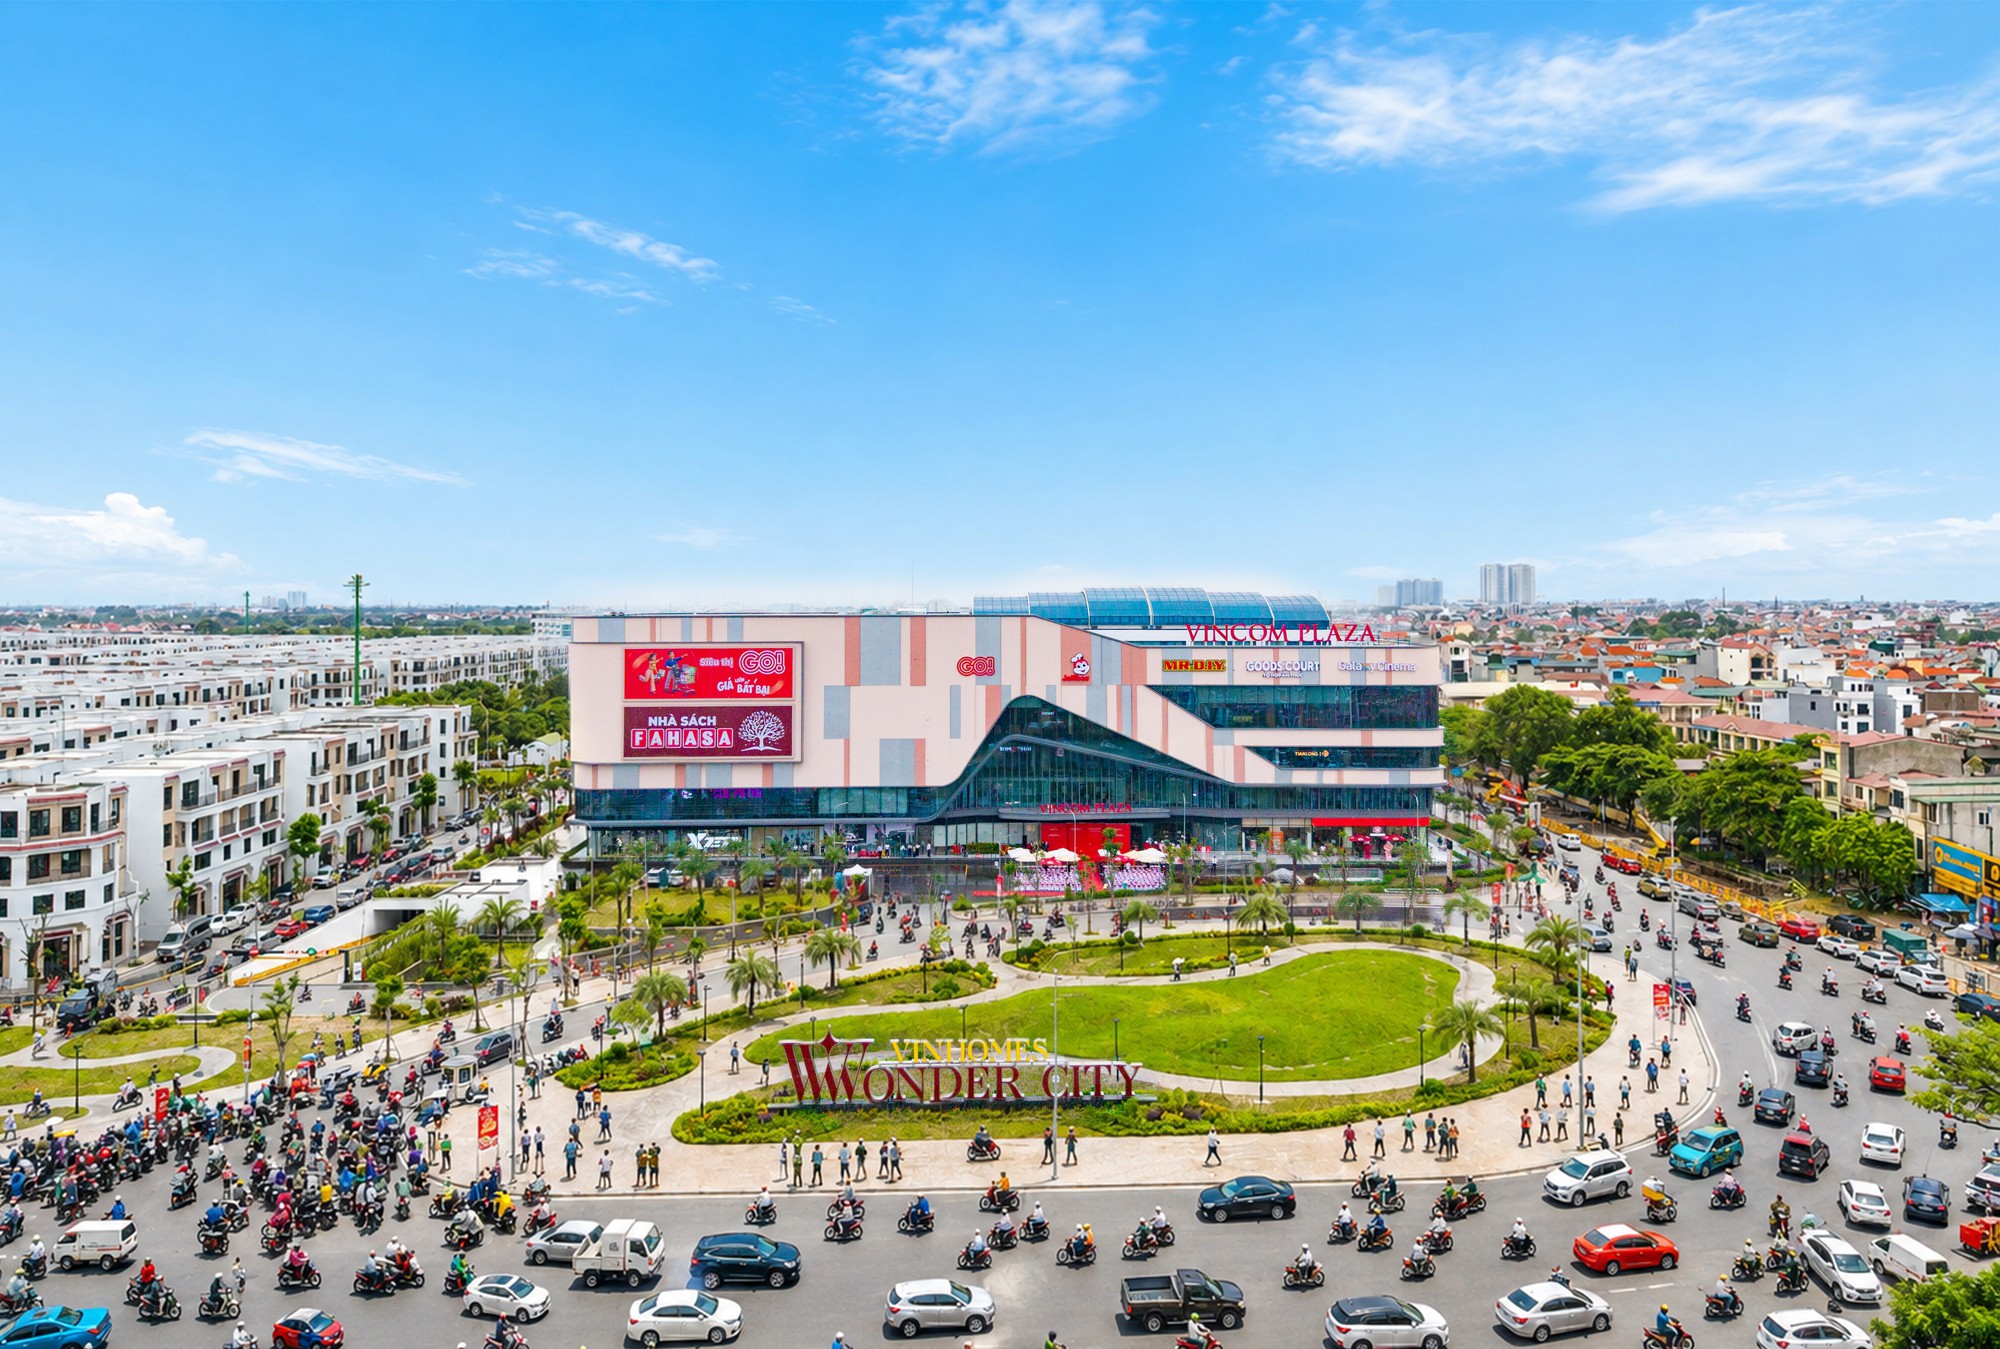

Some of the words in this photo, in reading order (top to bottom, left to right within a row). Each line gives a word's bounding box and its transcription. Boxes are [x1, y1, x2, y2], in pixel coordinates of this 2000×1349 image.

[1185, 623, 1288, 642] VINCOM
[1298, 623, 1377, 642] PLAZA
[739, 650, 785, 675] GO!
[957, 656, 995, 676] GO!
[1246, 660, 1283, 672] GOODS
[1285, 660, 1320, 672] COURT
[1377, 661, 1417, 672] Cinema
[717, 677, 734, 692] GIÁ
[737, 679, 755, 694] BẤT
[755, 685, 770, 697] BẠI
[648, 713, 678, 727] NHÀ
[680, 713, 717, 727] SÁCH
[633, 730, 732, 747] FAHASA
[1038, 803, 1090, 814] VINCOM
[1093, 803, 1133, 813] PLAZA
[889, 1037, 1048, 1062] VINHOMES
[1042, 1060, 1143, 1099] CITY
